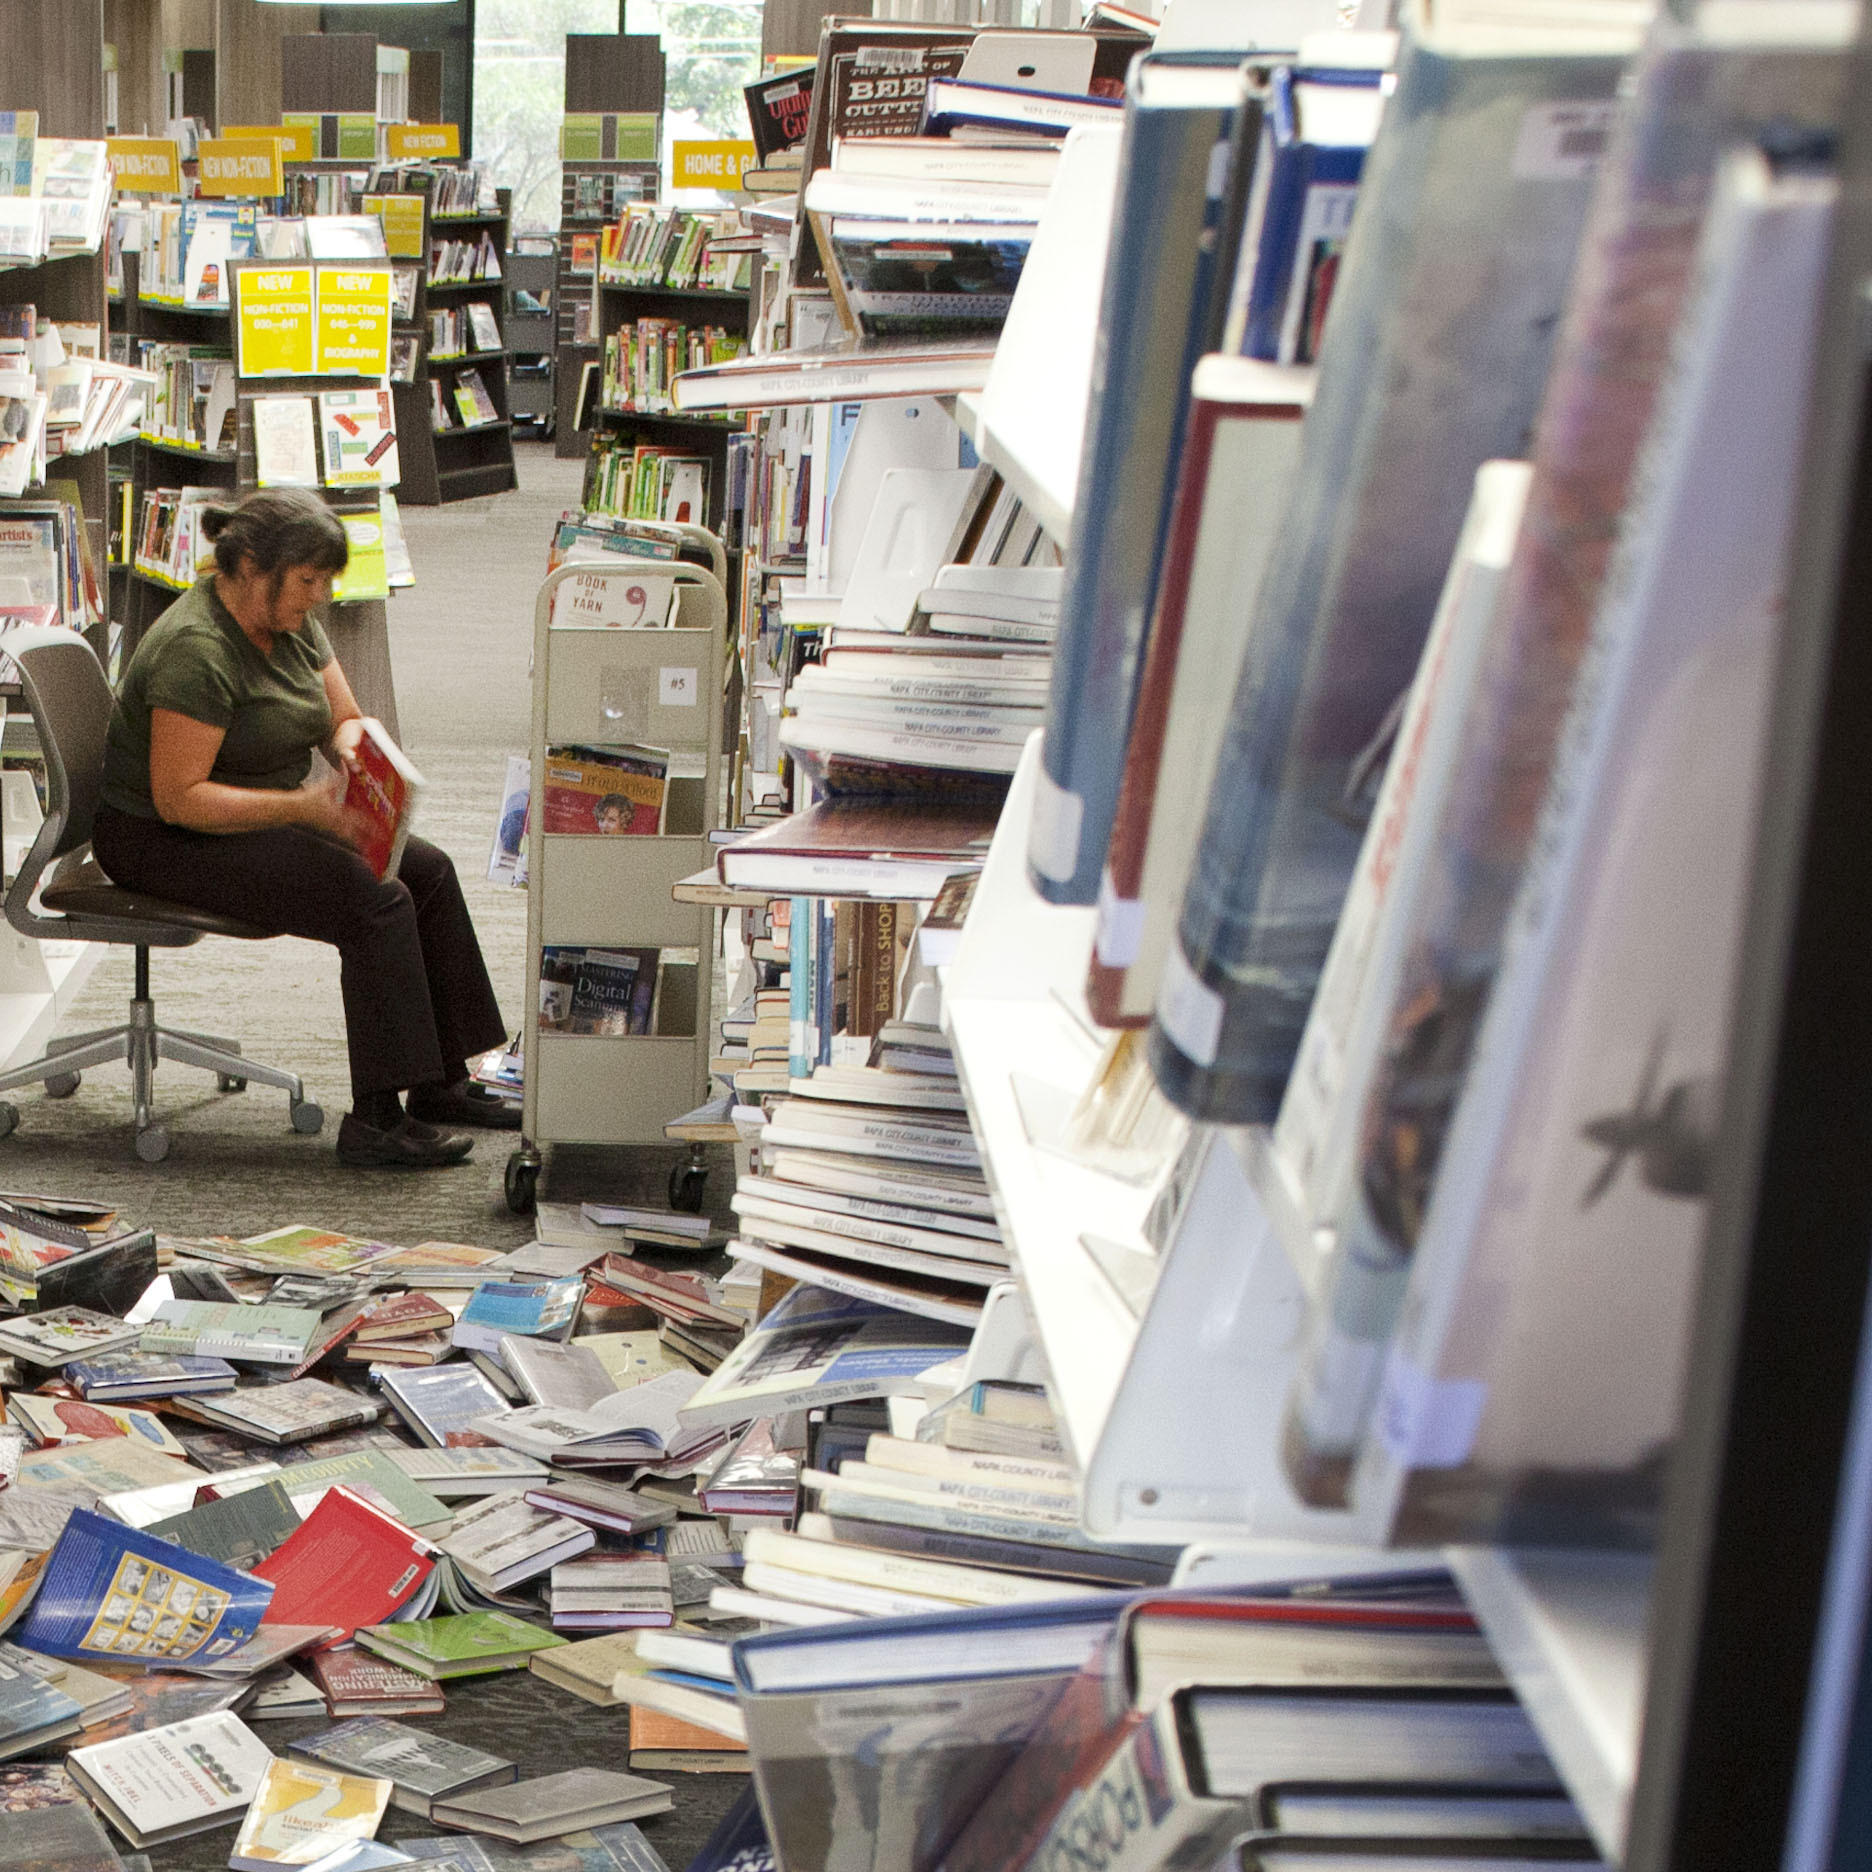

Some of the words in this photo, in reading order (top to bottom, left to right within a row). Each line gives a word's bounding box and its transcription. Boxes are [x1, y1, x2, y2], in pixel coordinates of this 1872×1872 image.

[402, 134, 419, 149] NEW
[421, 134, 446, 149] FICTION
[203, 156, 220, 176] NEW
[222, 157, 269, 177] NON-FICTION
[257, 275, 293, 291] NEW
[336, 275, 373, 291] NEW
[243, 302, 309, 315] NON-FICTION
[321, 303, 385, 316] NON-FICTION
[324, 347, 380, 359] BIOGRAPHY
[577, 574, 607, 592] BOOK
[573, 597, 603, 614] YARN
[670, 677, 685, 690] #5
[904, 722, 924, 733] NAPA
[969, 726, 1002, 736] LIBRARY
[878, 903, 894, 950] SHOP
[576, 977, 631, 1000] Digital
[876, 975, 891, 1011] Back
[863, 1125, 884, 1137] NAPA
[930, 1134, 963, 1147] LIBRARY
